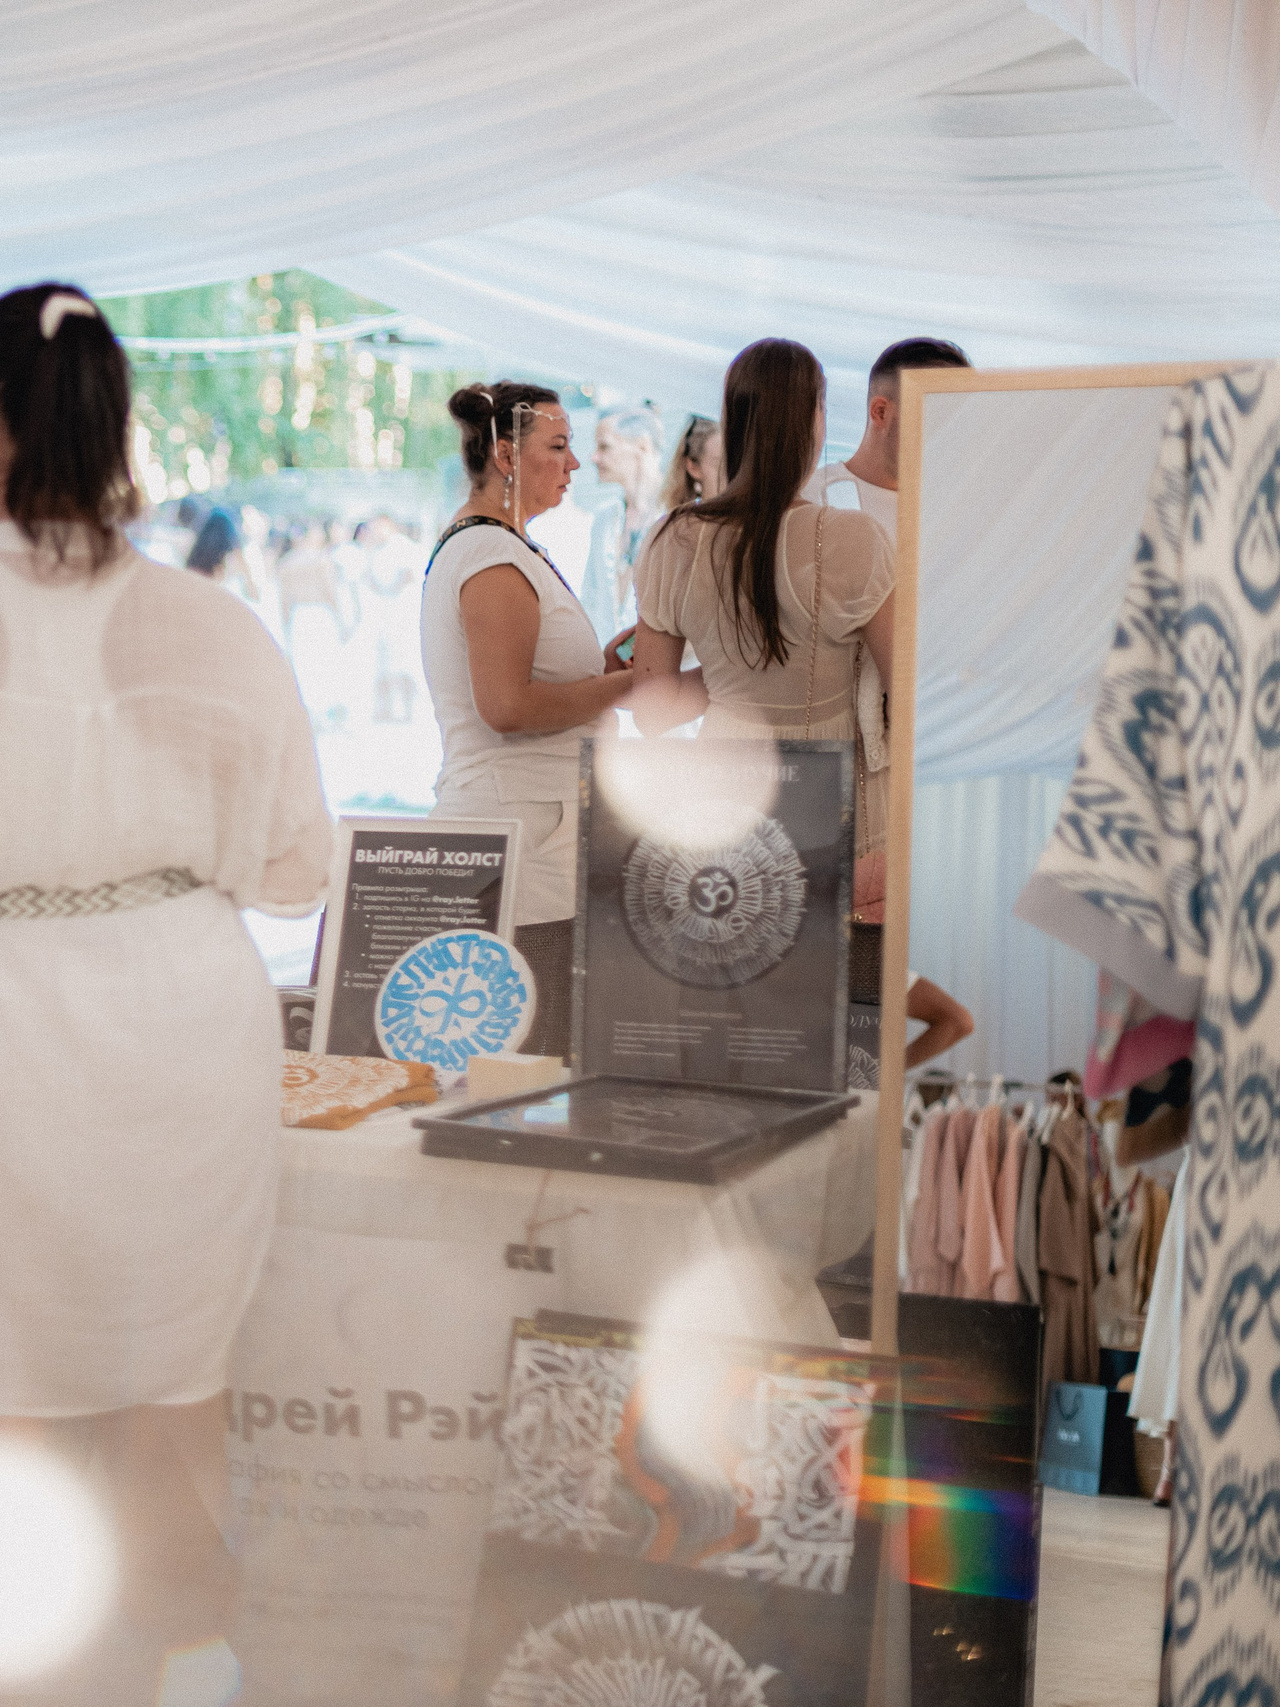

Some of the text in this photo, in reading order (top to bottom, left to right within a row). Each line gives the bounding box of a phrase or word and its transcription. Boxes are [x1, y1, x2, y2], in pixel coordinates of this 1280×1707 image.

[355, 846, 503, 867] ВЫЙГРАЙ ХОЛСТ
[377, 866, 475, 878] ПУСТЬ ДОБРО ПОБЕДИТ
